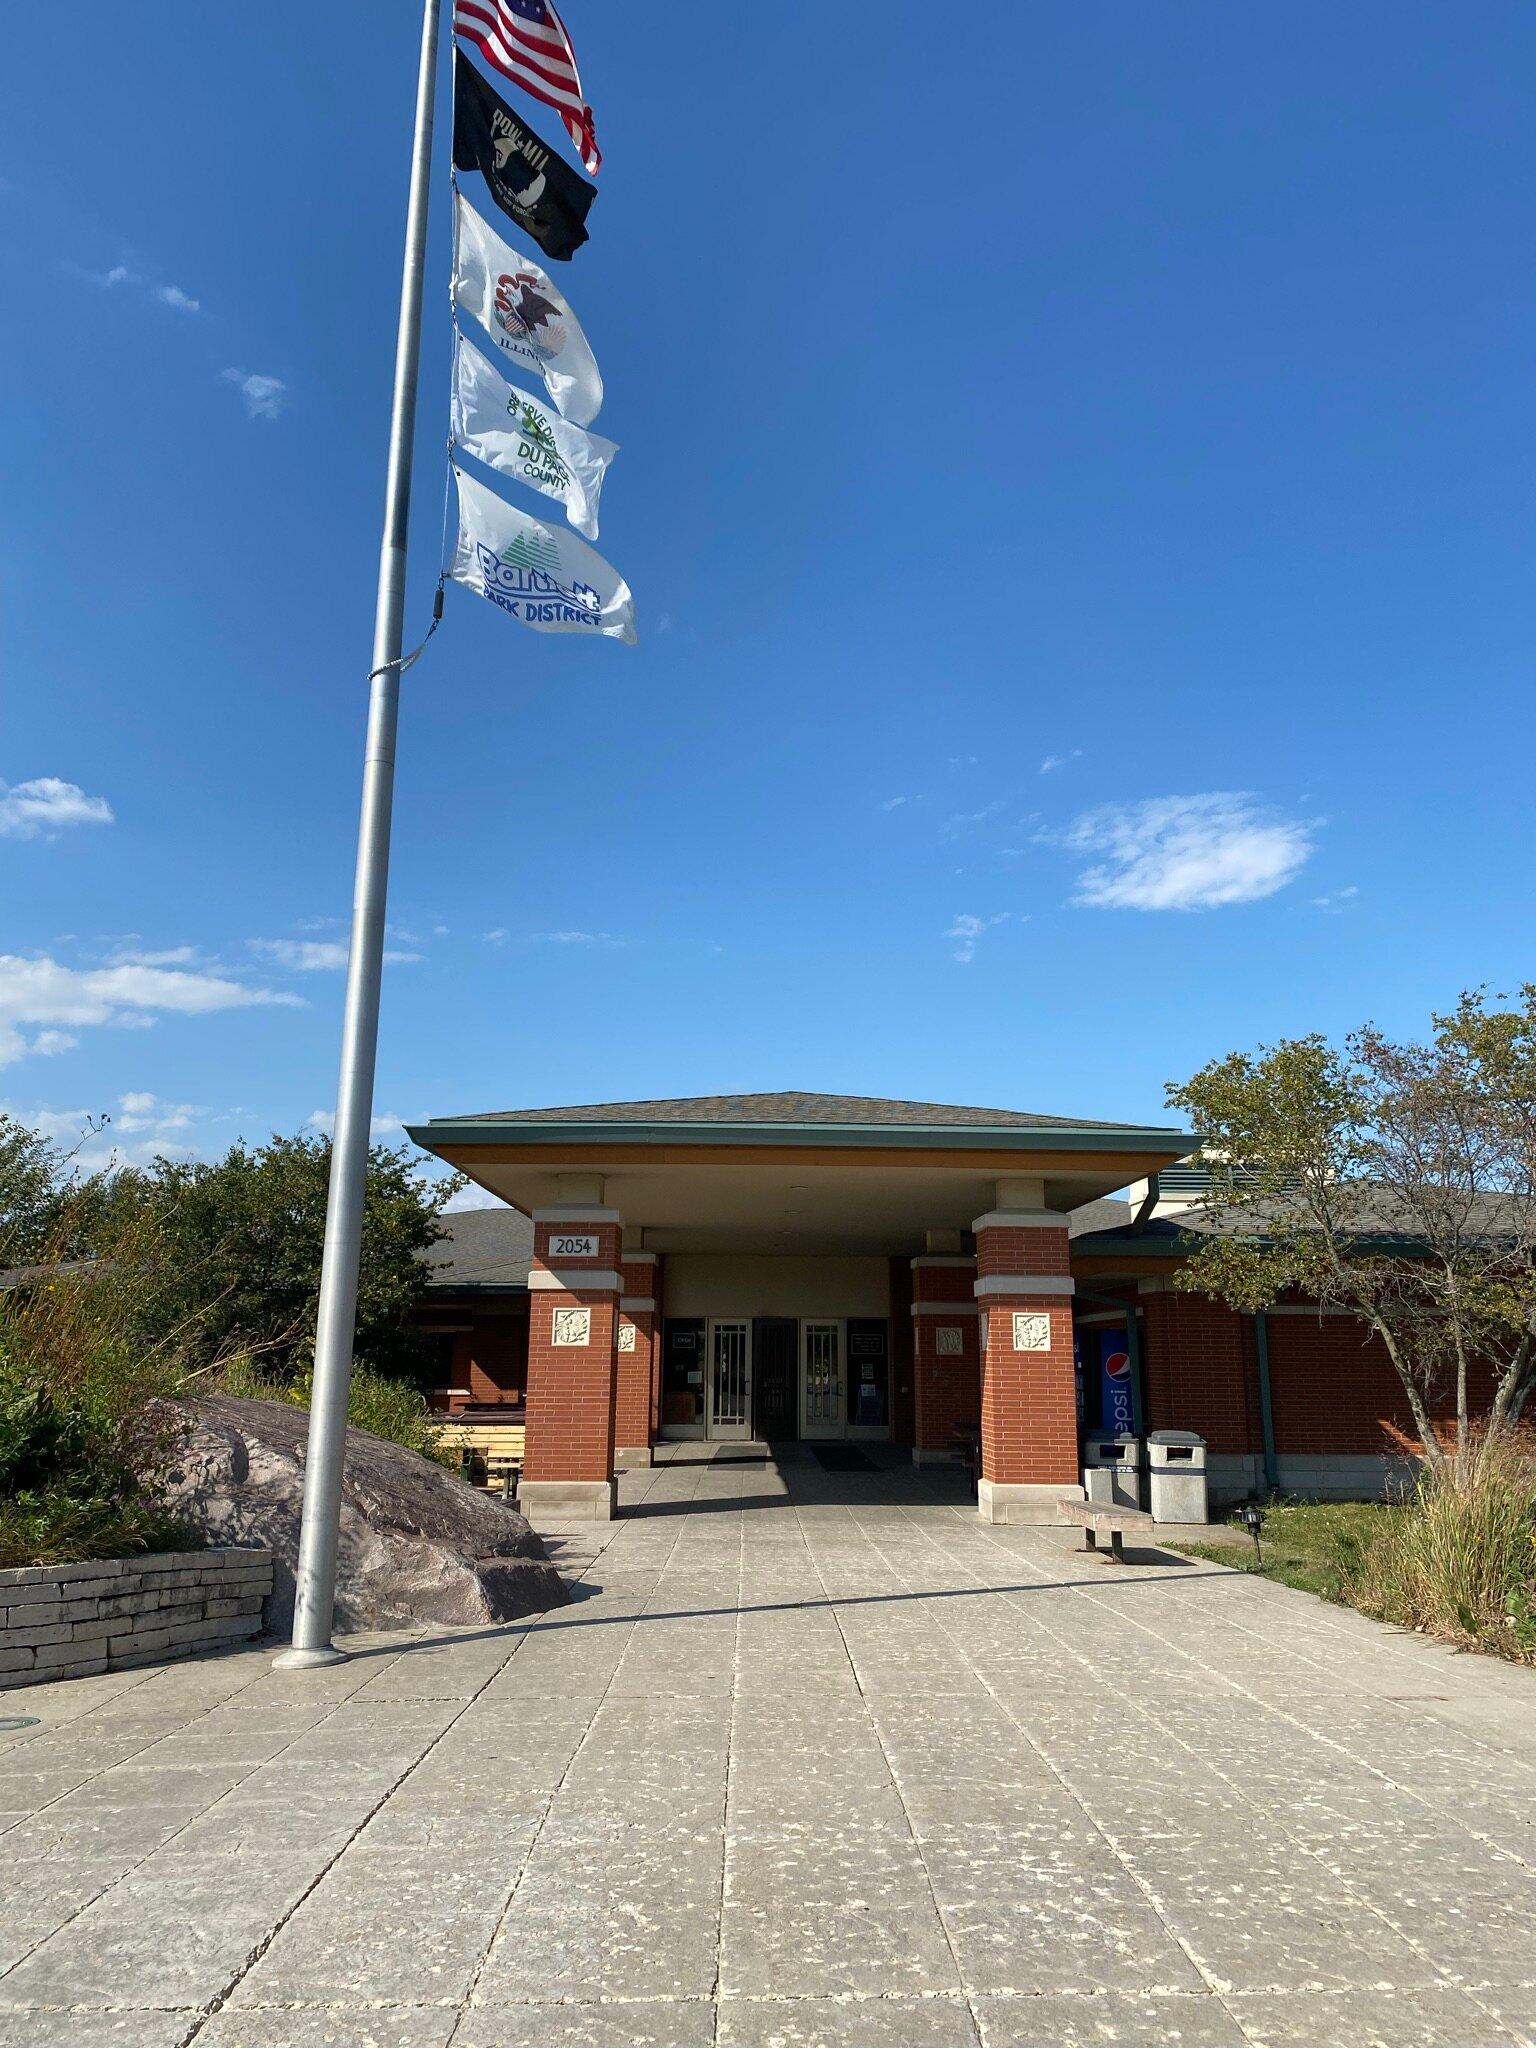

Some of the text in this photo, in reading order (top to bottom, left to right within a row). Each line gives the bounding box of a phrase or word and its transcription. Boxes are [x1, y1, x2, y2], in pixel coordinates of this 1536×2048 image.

[518, 442, 540, 463] DU
[523, 463, 566, 490] COUNTY
[525, 603, 602, 626] DISTRICT
[555, 1238, 592, 1254] 2054
[1110, 1389, 1132, 1432] epsi
